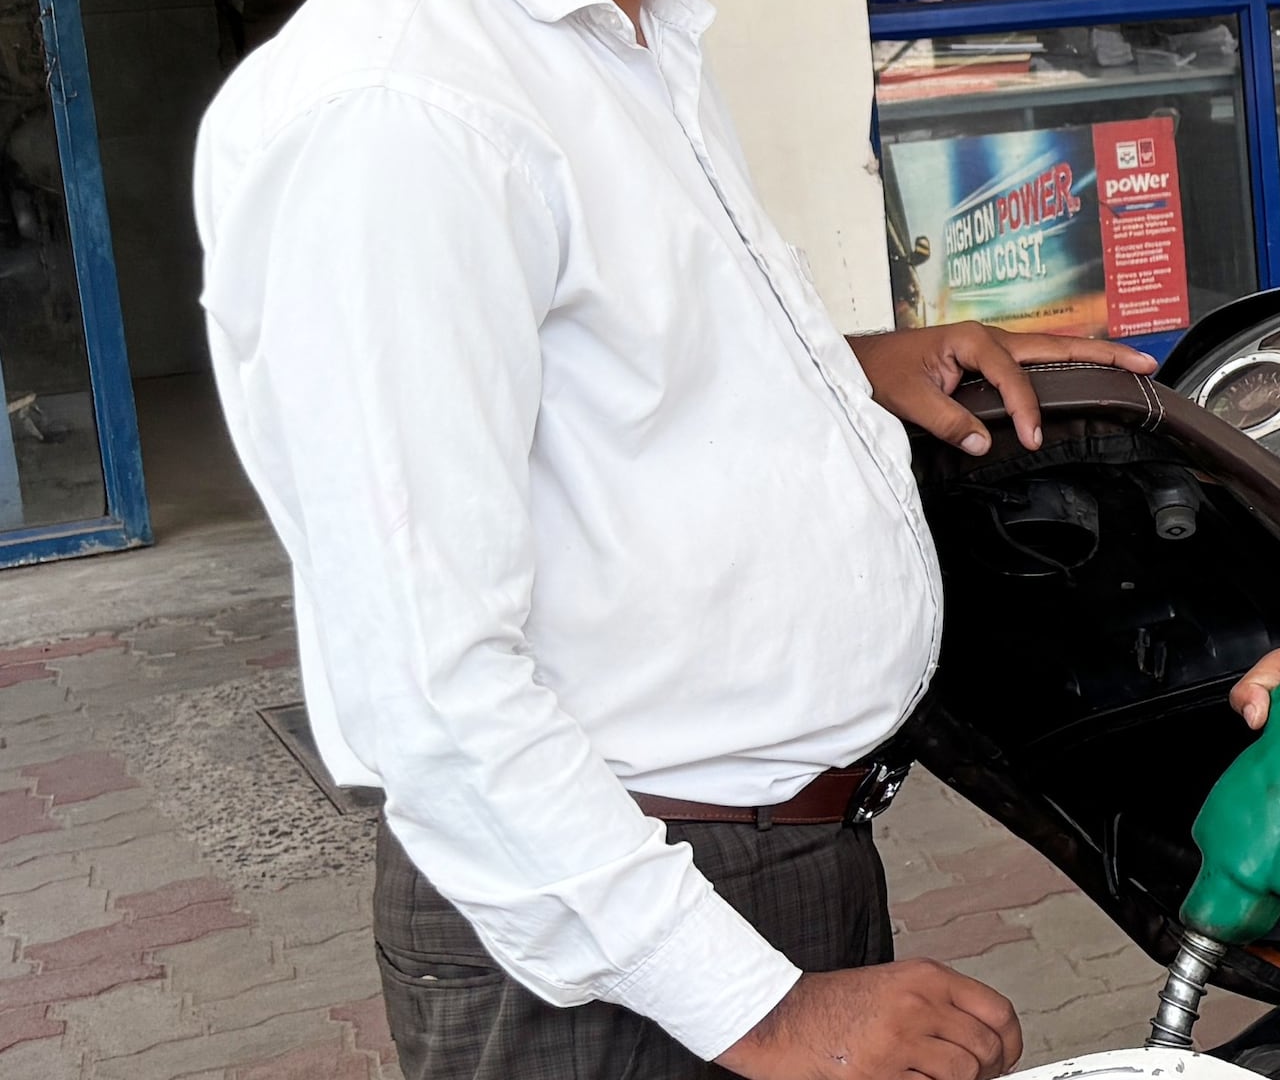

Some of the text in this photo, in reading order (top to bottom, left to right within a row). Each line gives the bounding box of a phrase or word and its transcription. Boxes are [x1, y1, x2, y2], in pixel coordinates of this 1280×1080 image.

[945, 214, 973, 257] HIGH
[974, 201, 996, 245] ON
[947, 230, 1047, 288] LOW ON COST.
